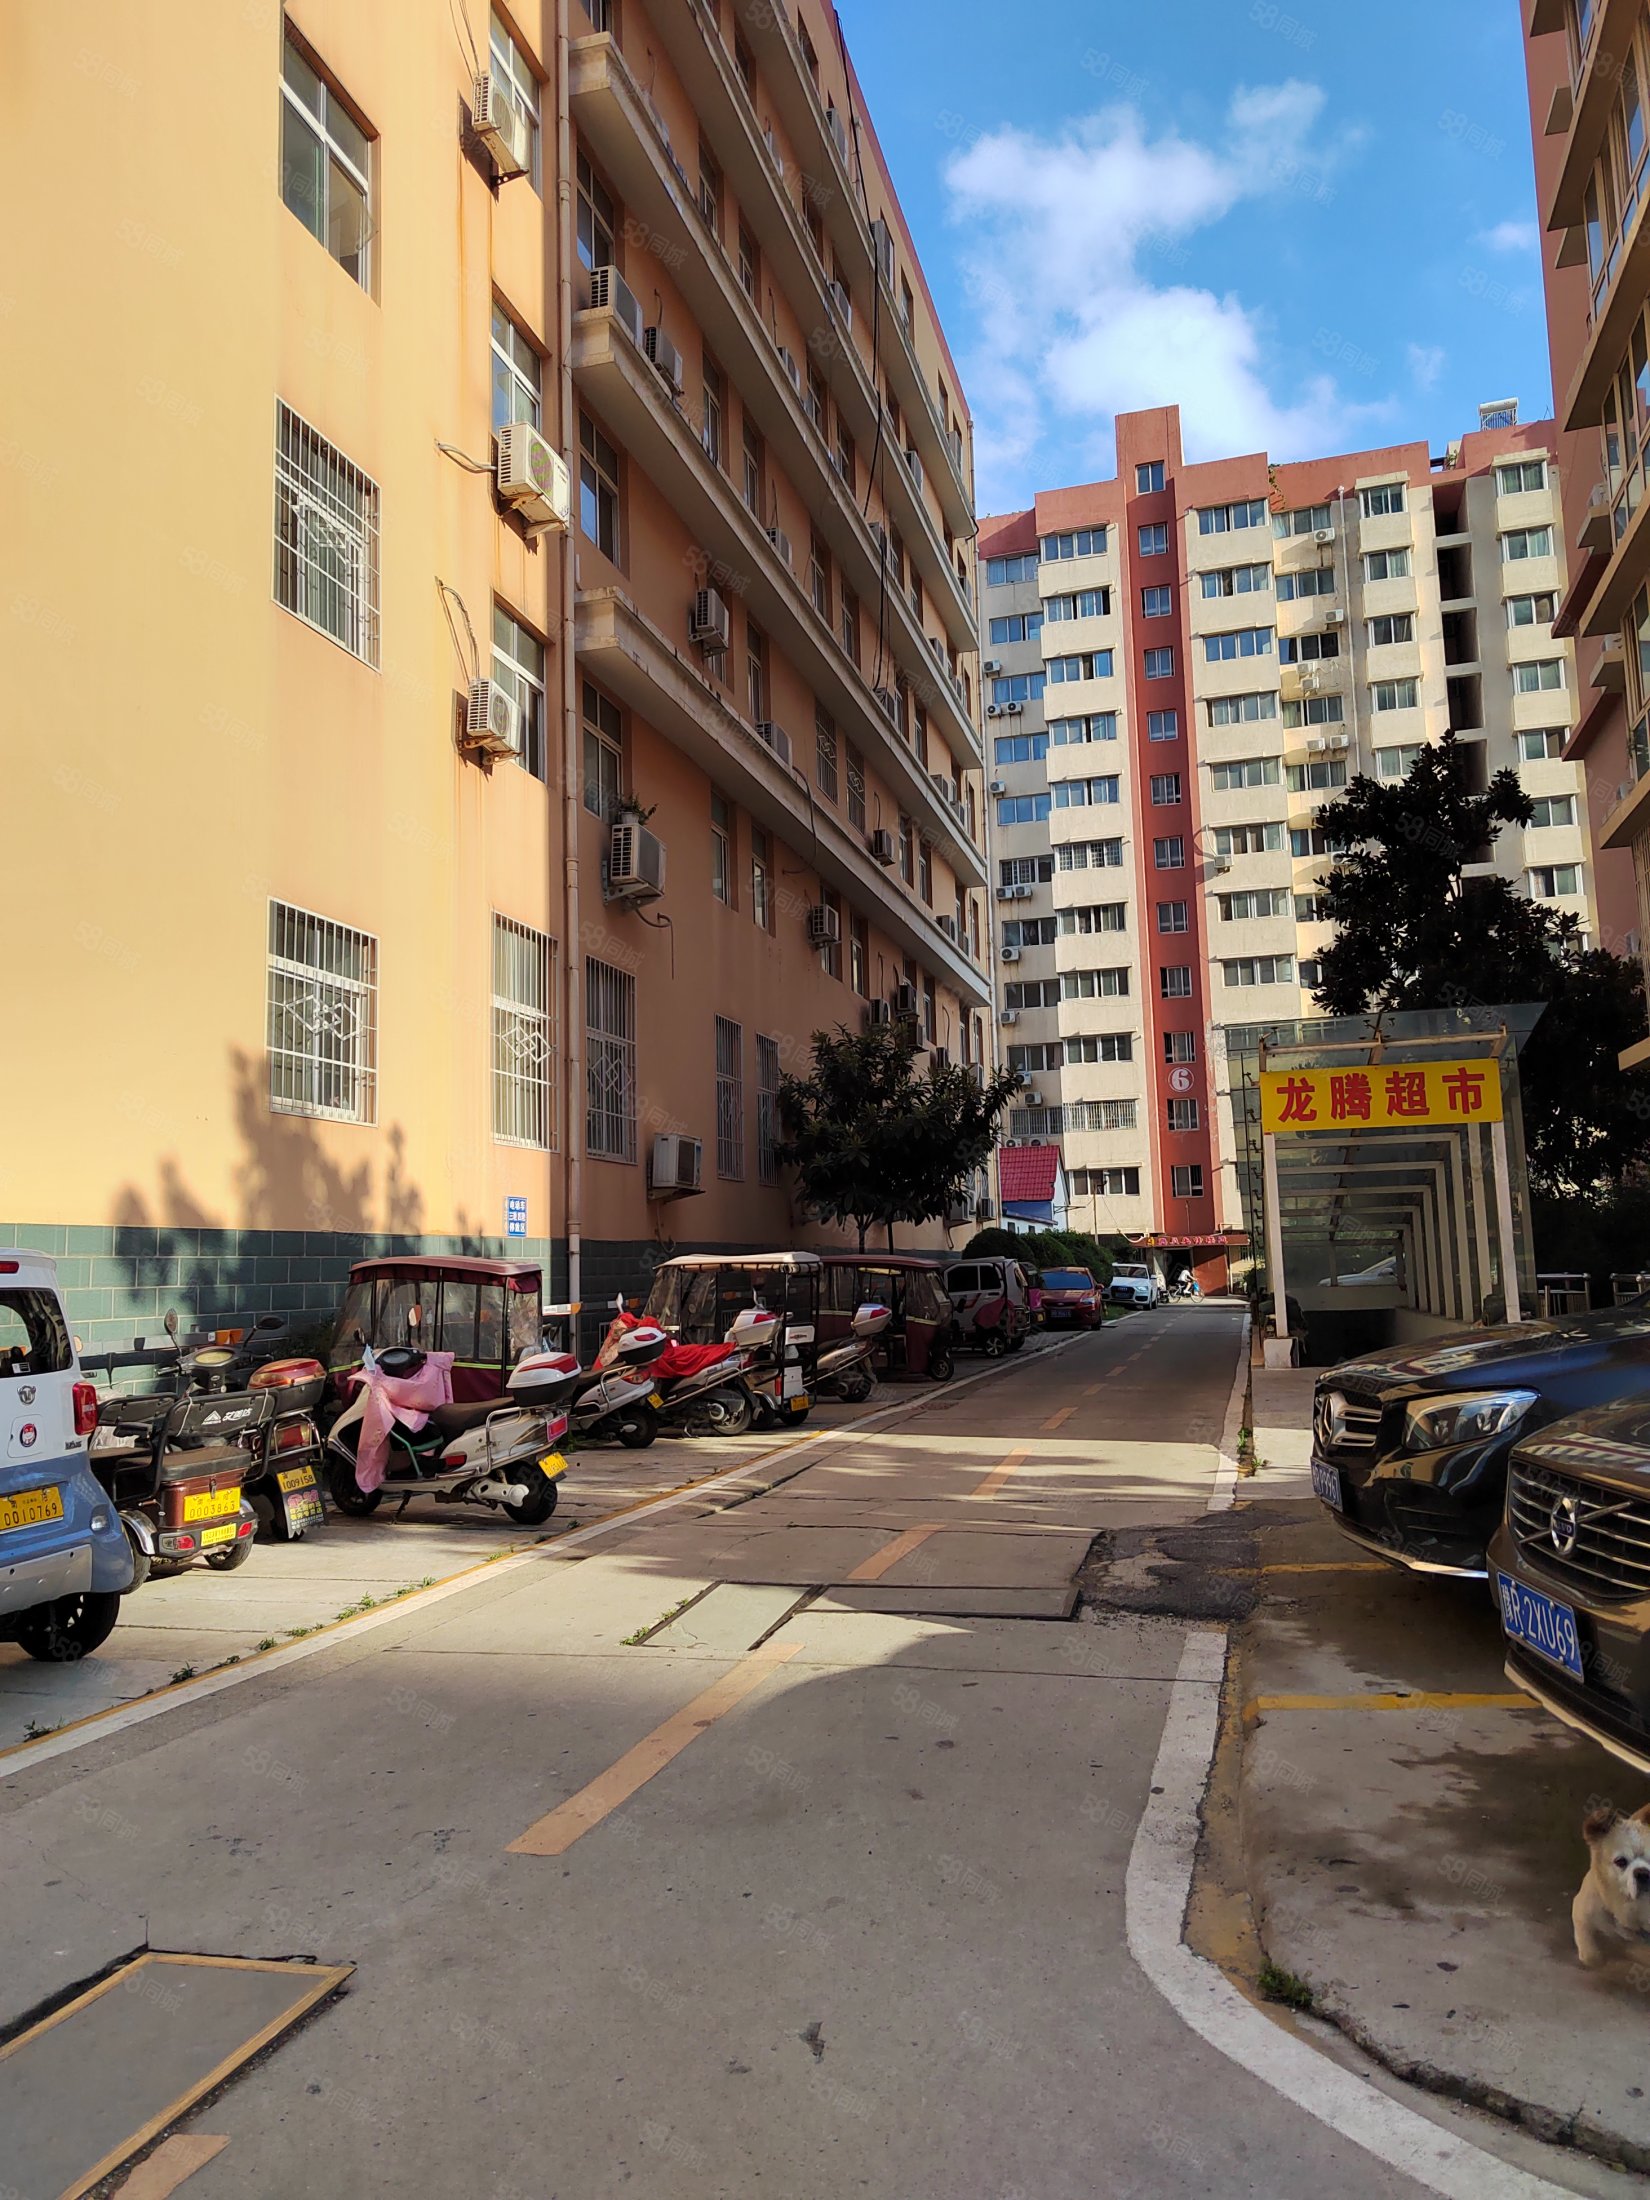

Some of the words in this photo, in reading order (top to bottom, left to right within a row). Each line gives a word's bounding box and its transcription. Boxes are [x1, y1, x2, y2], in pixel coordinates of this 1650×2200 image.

[1172, 1071, 1191, 1091] 6
[1276, 1067, 1485, 1122] 龙腾超市
[4, 1502, 58, 1526] 0010769
[189, 1500, 235, 1518] 0003863
